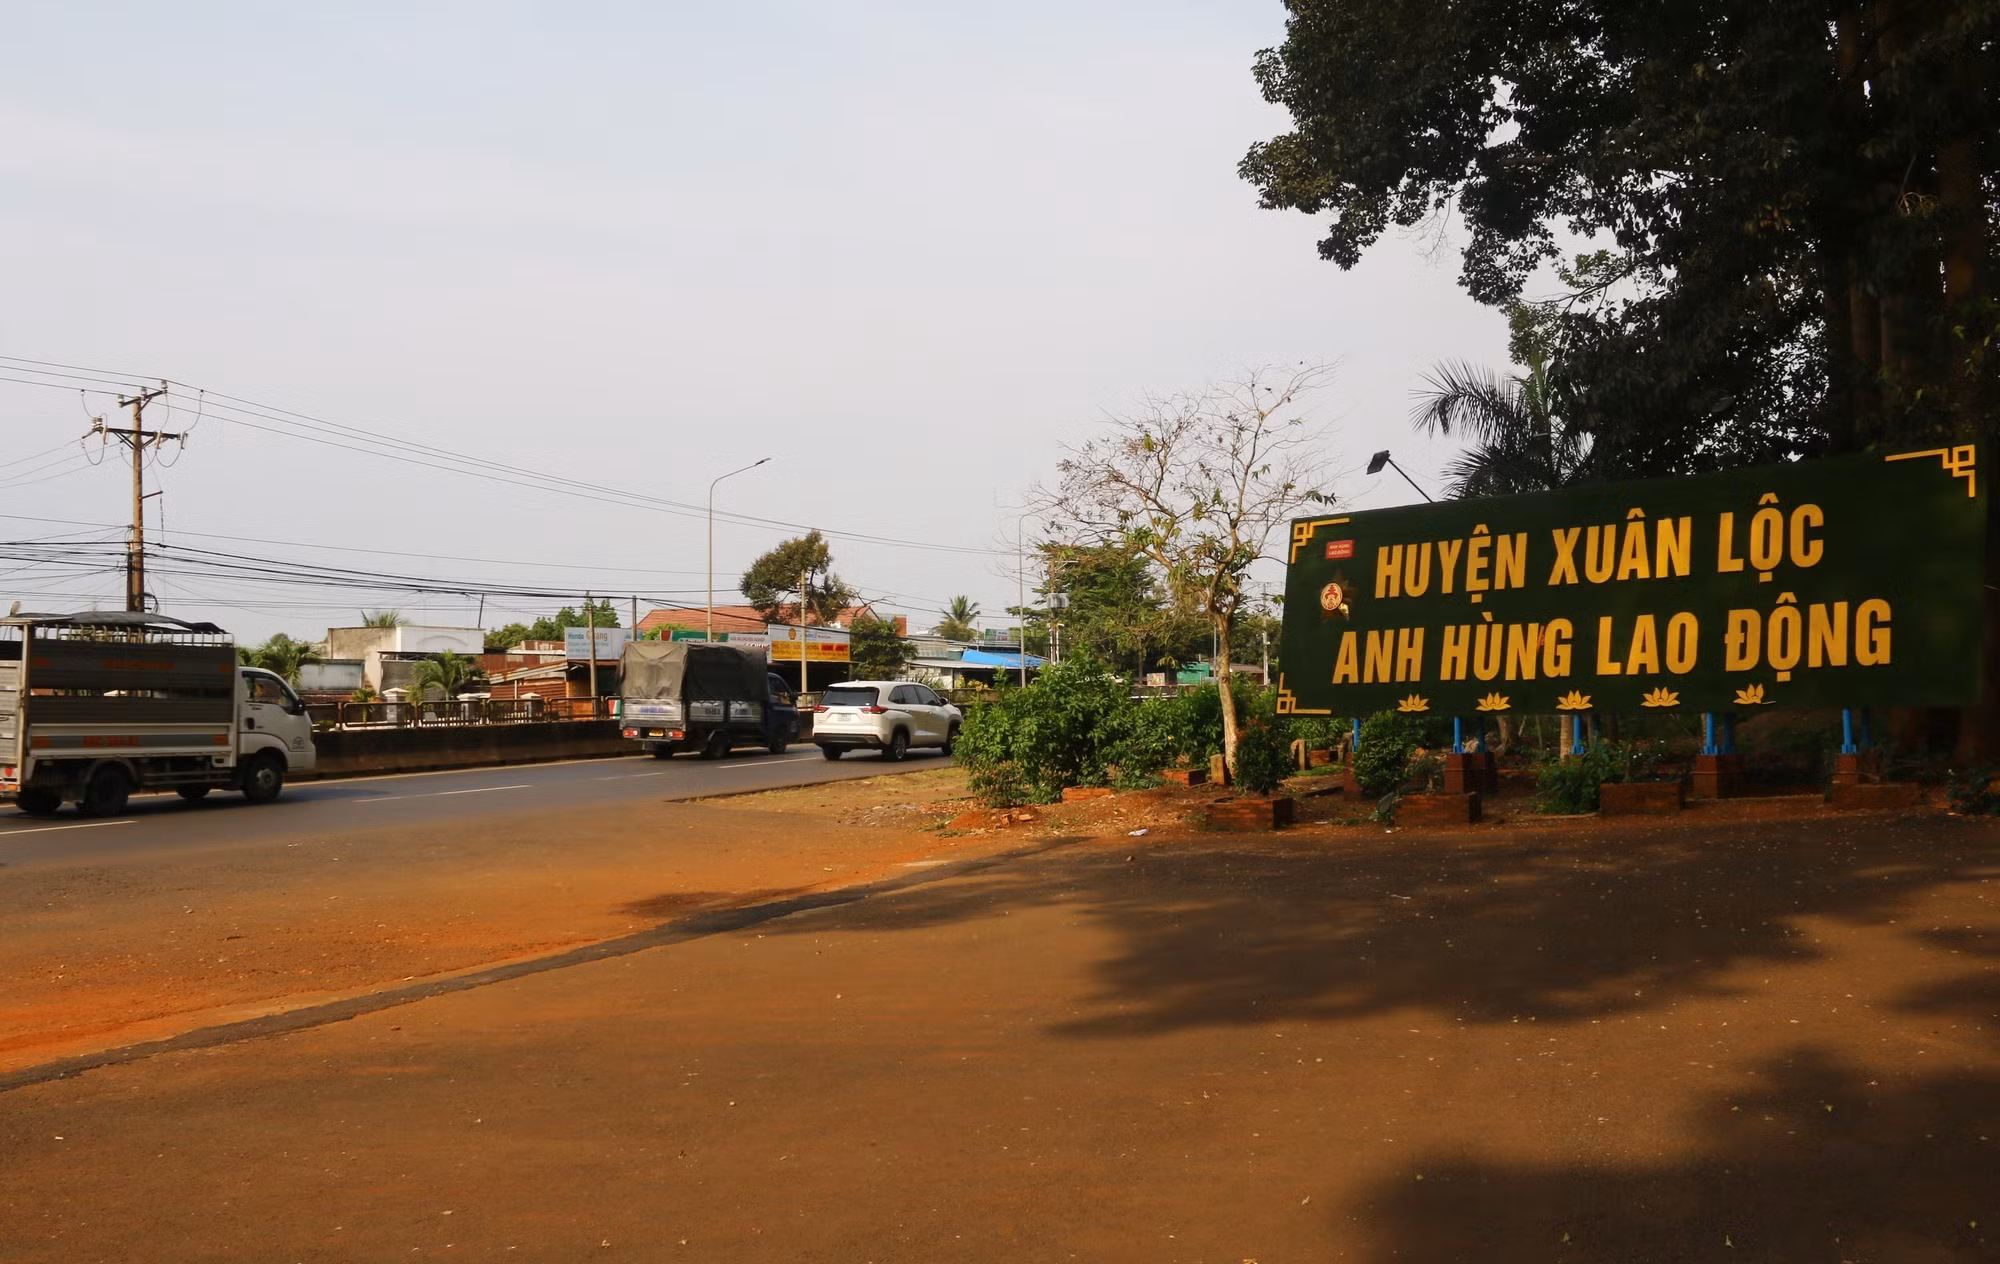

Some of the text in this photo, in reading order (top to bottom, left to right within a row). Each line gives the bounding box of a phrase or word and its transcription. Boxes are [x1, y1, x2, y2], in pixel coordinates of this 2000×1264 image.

[1374, 492, 1824, 604] HUYỆN XUÂN LỘC
[1332, 591, 1891, 684] ANH HÙNG LAO ĐỘNG
